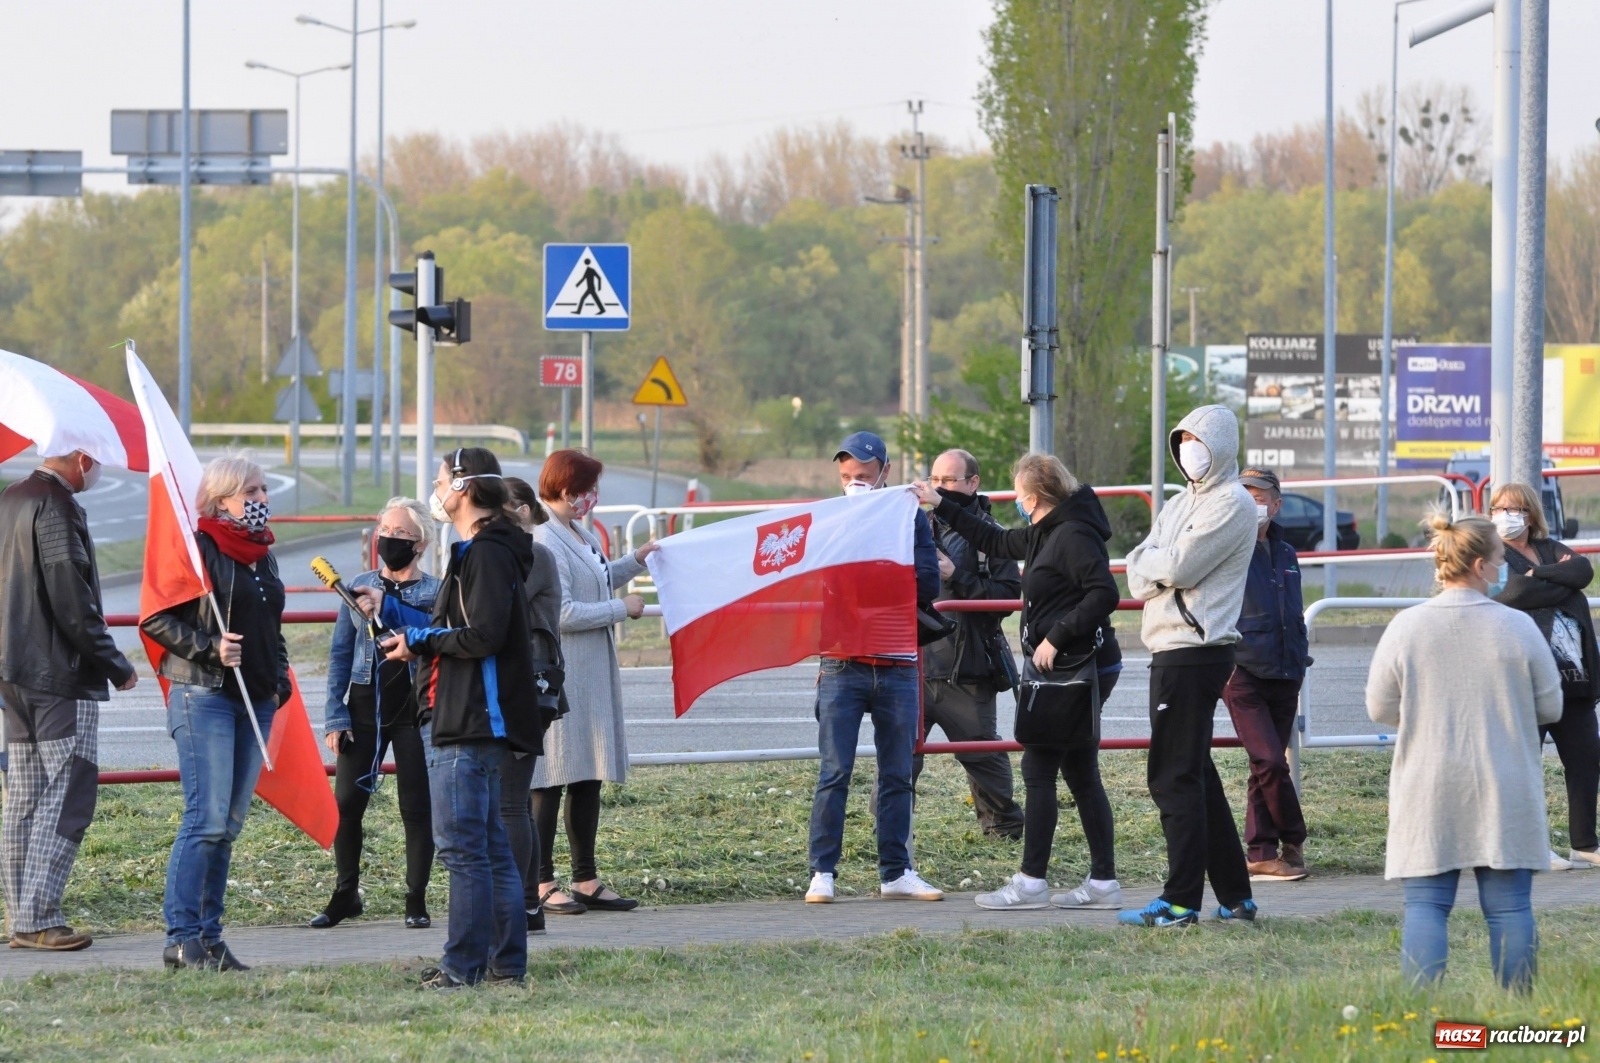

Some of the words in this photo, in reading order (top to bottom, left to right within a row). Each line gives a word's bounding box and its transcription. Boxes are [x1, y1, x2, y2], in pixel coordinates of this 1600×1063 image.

[1249, 337, 1317, 350] KOLEJARZ
[1249, 352, 1272, 360] BEST
[1274, 352, 1293, 360] FOR
[1296, 352, 1317, 361] YOU
[554, 362, 577, 381] 78
[1407, 395, 1481, 414] DRZWI
[1407, 415, 1463, 429] dostępne
[1465, 415, 1482, 427] od
[1340, 427, 1349, 439] W
[311, 565, 330, 585] RMF
